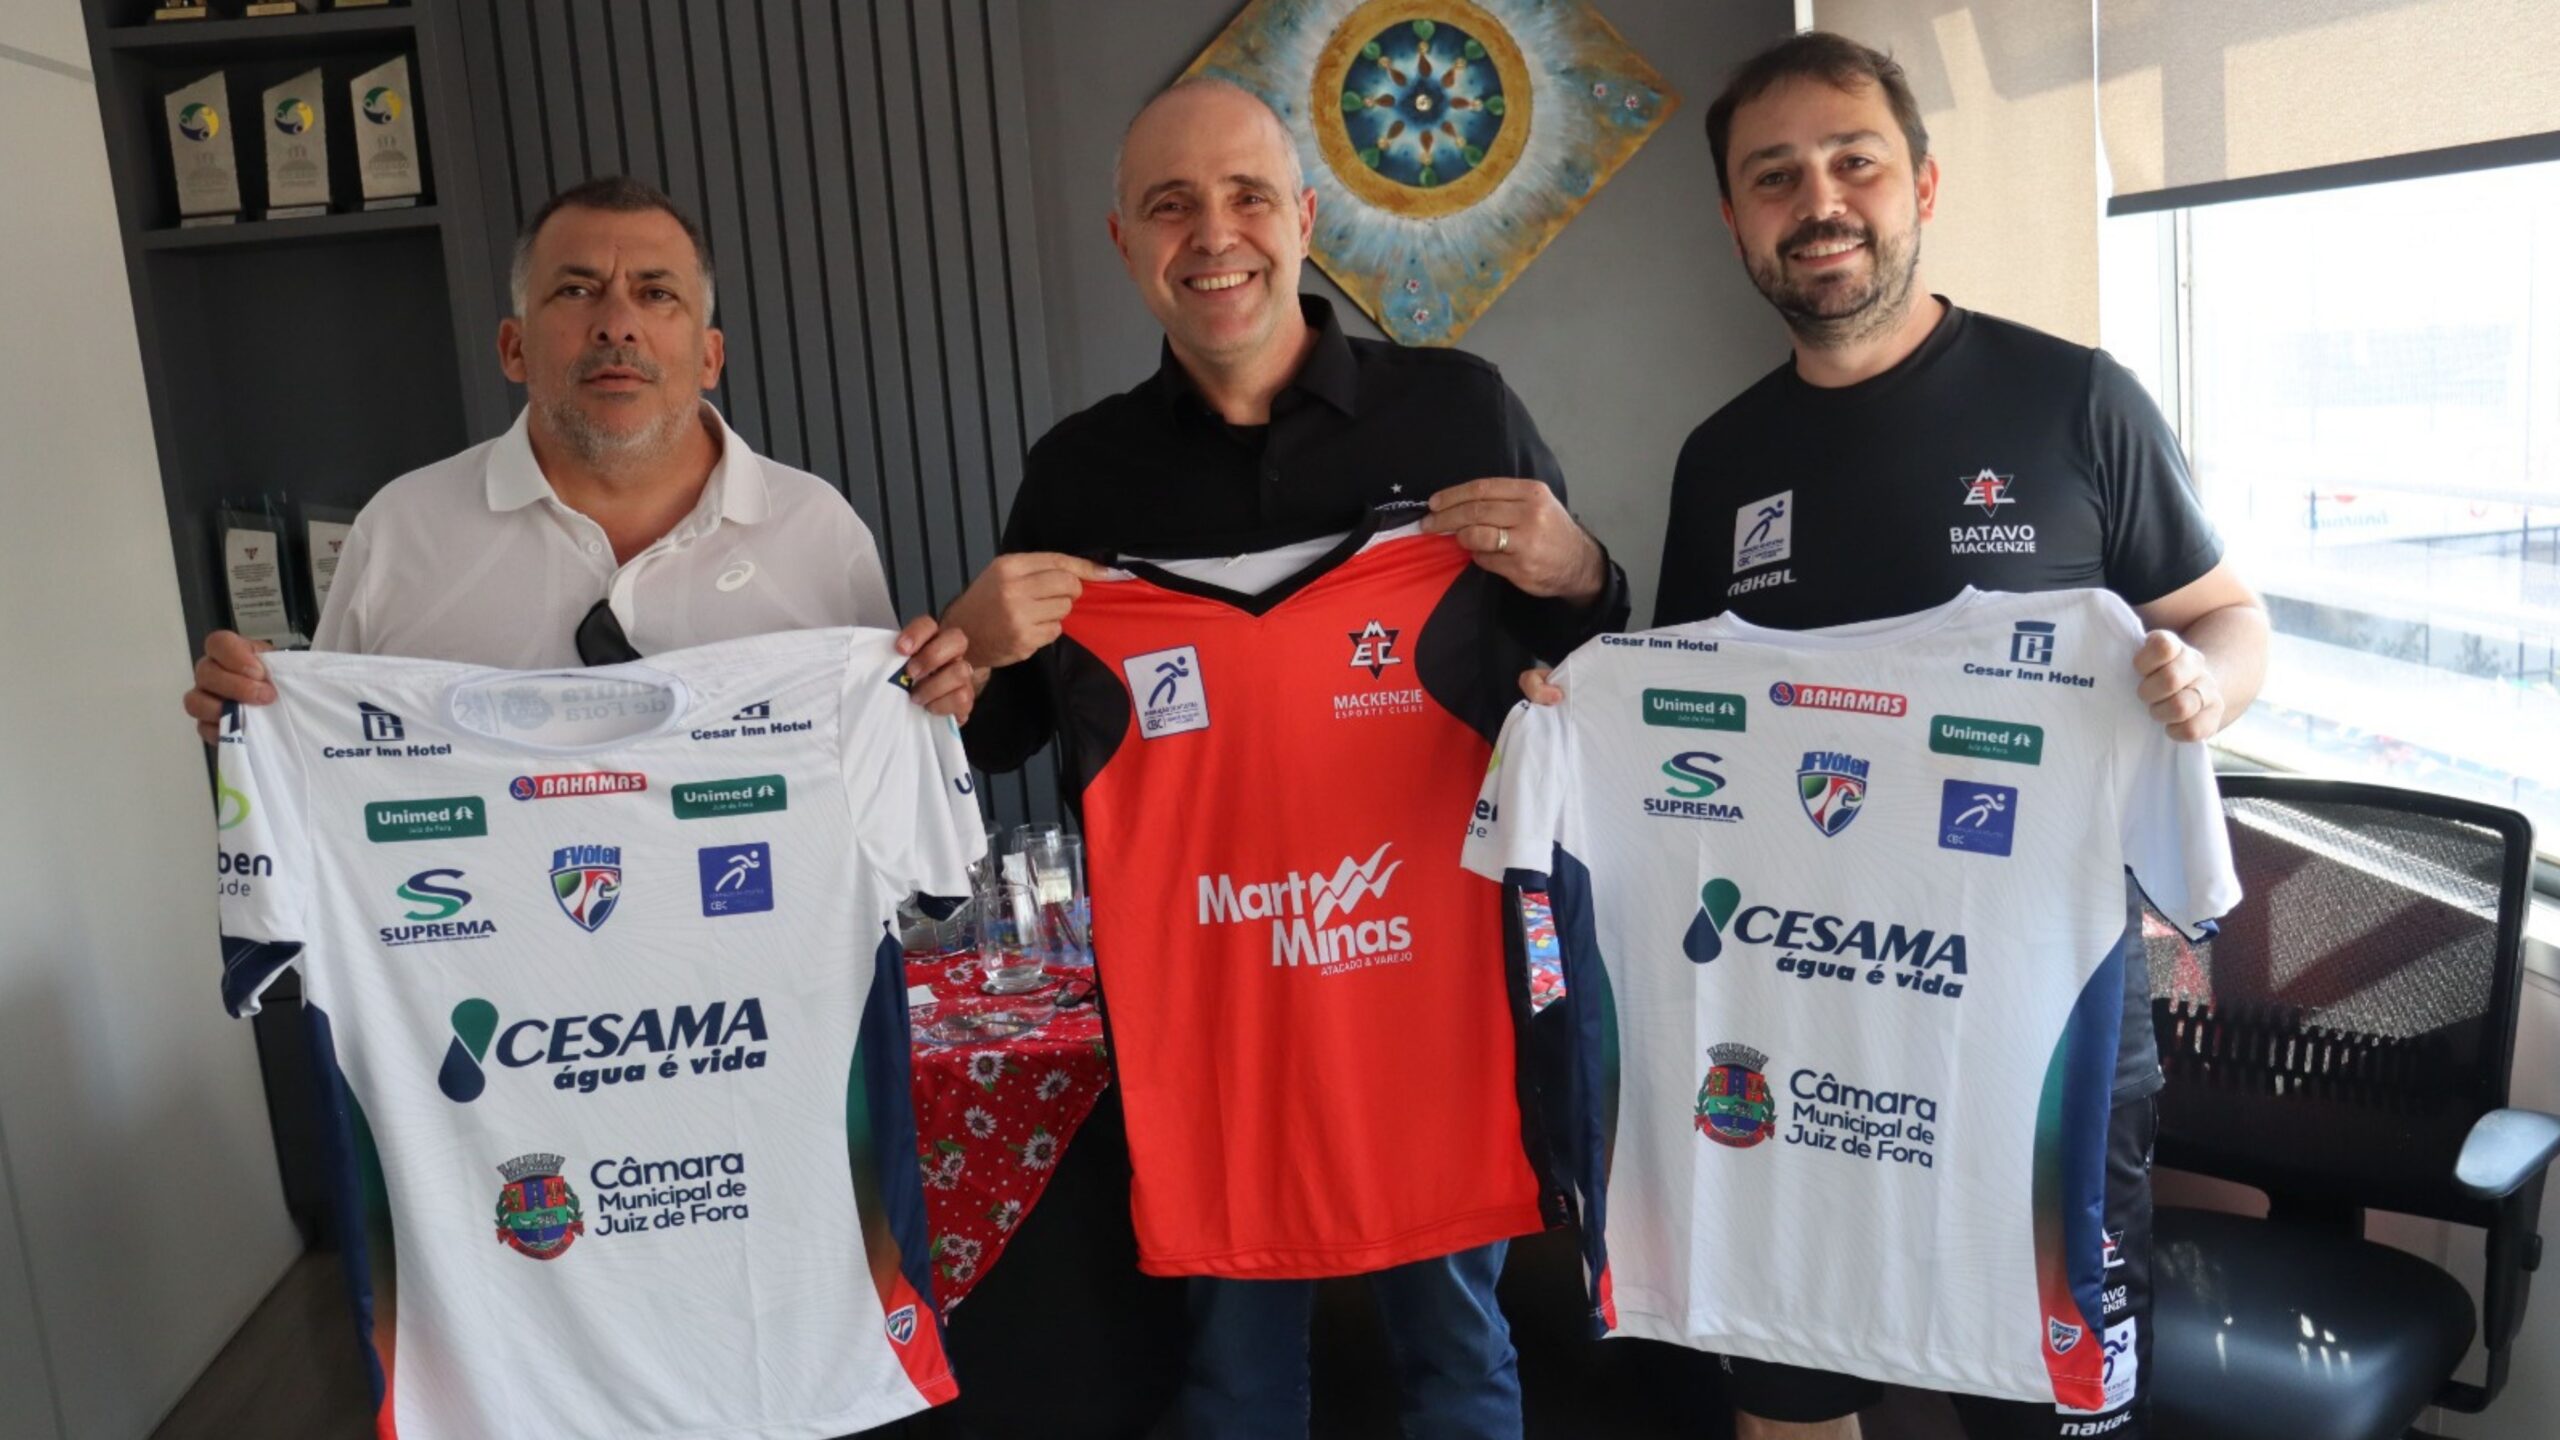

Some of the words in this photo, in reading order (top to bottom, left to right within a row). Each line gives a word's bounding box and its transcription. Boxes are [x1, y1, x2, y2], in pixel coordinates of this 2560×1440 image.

[1949, 525, 2035, 542] BATAVO
[1951, 541, 2036, 555] MACKENZIE
[1601, 635, 1645, 647] Cesar
[1649, 637, 1672, 649] Inn
[1677, 639, 1718, 653] Hotel
[1963, 663, 2013, 678] Cesar
[2017, 668, 2044, 682] Inn
[2048, 671, 2095, 689] Hotel
[1333, 688, 1424, 710] MACKENZIE
[1335, 707, 1383, 719] ESPORTE
[1389, 704, 1423, 714] CLUBE
[1653, 696, 1715, 714] Unimed
[1800, 688, 1902, 715] BAHAMAS
[691, 729, 737, 741] Cesar
[741, 725, 766, 737] Inn
[770, 719, 812, 734] Hotel
[1941, 724, 2010, 745] Unimed
[323, 746, 372, 759] Cesar
[376, 745, 402, 757] Inn
[406, 743, 452, 757] Hotel
[542, 774, 642, 796] BAHAMAS
[683, 787, 753, 803] Unimed
[377, 807, 450, 825] Unimed
[1643, 798, 1744, 819] SUPREMA
[1198, 871, 1306, 925] Mart
[380, 919, 498, 943] SUPREMA
[1272, 916, 1412, 967] Minas
[1734, 905, 1967, 975] CESAMA
[1320, 959, 1362, 976] ATACADO
[1374, 951, 1413, 965] VAREJO
[1776, 951, 1856, 982] água
[1866, 964, 1885, 985] é
[1896, 970, 1964, 999] vida
[496, 997, 768, 1068] CESAMA
[553, 1064, 646, 1093] água
[658, 1054, 678, 1078] é
[690, 1046, 766, 1075] vida
[1789, 1068, 1937, 1123] Câmara
[1793, 1102, 1902, 1141] Municipal
[1906, 1122, 1934, 1145] de
[1785, 1124, 1837, 1151] Juiz
[1841, 1136, 1872, 1159] de
[1877, 1140, 1933, 1169] Fora
[590, 1152, 745, 1190] Câmara
[598, 1181, 711, 1212] Municipal
[717, 1179, 747, 1198] de
[595, 1212, 649, 1237] Juiz
[653, 1208, 685, 1229] de
[691, 1202, 749, 1224] Fora
